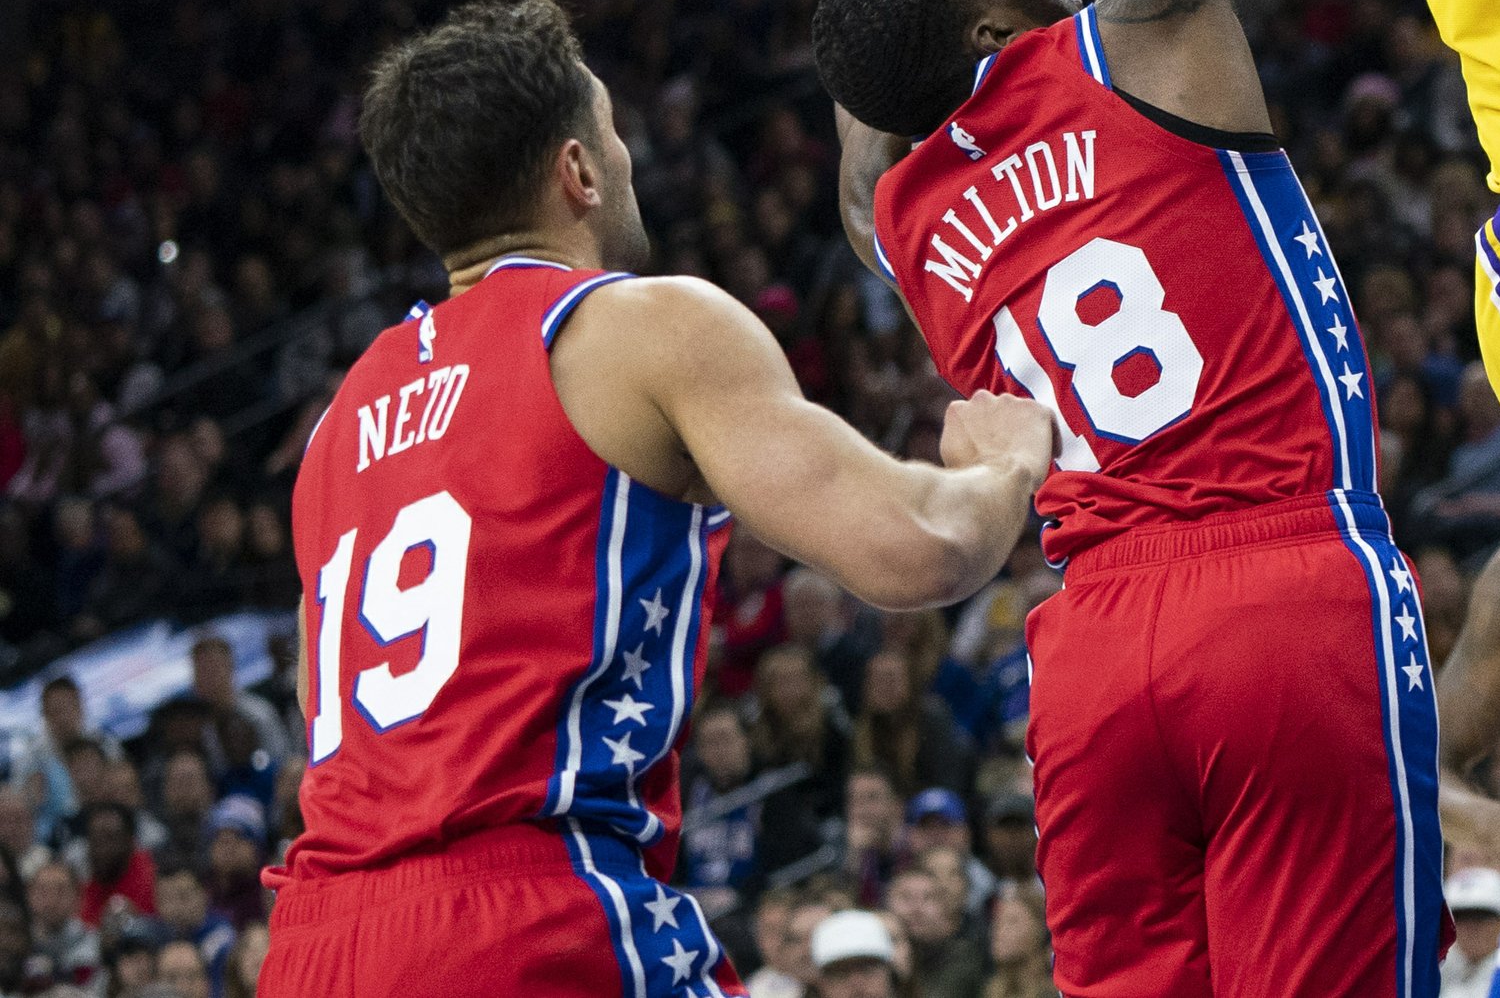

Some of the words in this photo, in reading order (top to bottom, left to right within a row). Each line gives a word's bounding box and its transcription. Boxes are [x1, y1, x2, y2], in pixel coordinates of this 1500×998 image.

[925, 130, 1097, 303] MILTON
[356, 364, 470, 473] NETO
[992, 237, 1204, 473] 18
[310, 490, 473, 768] 19
